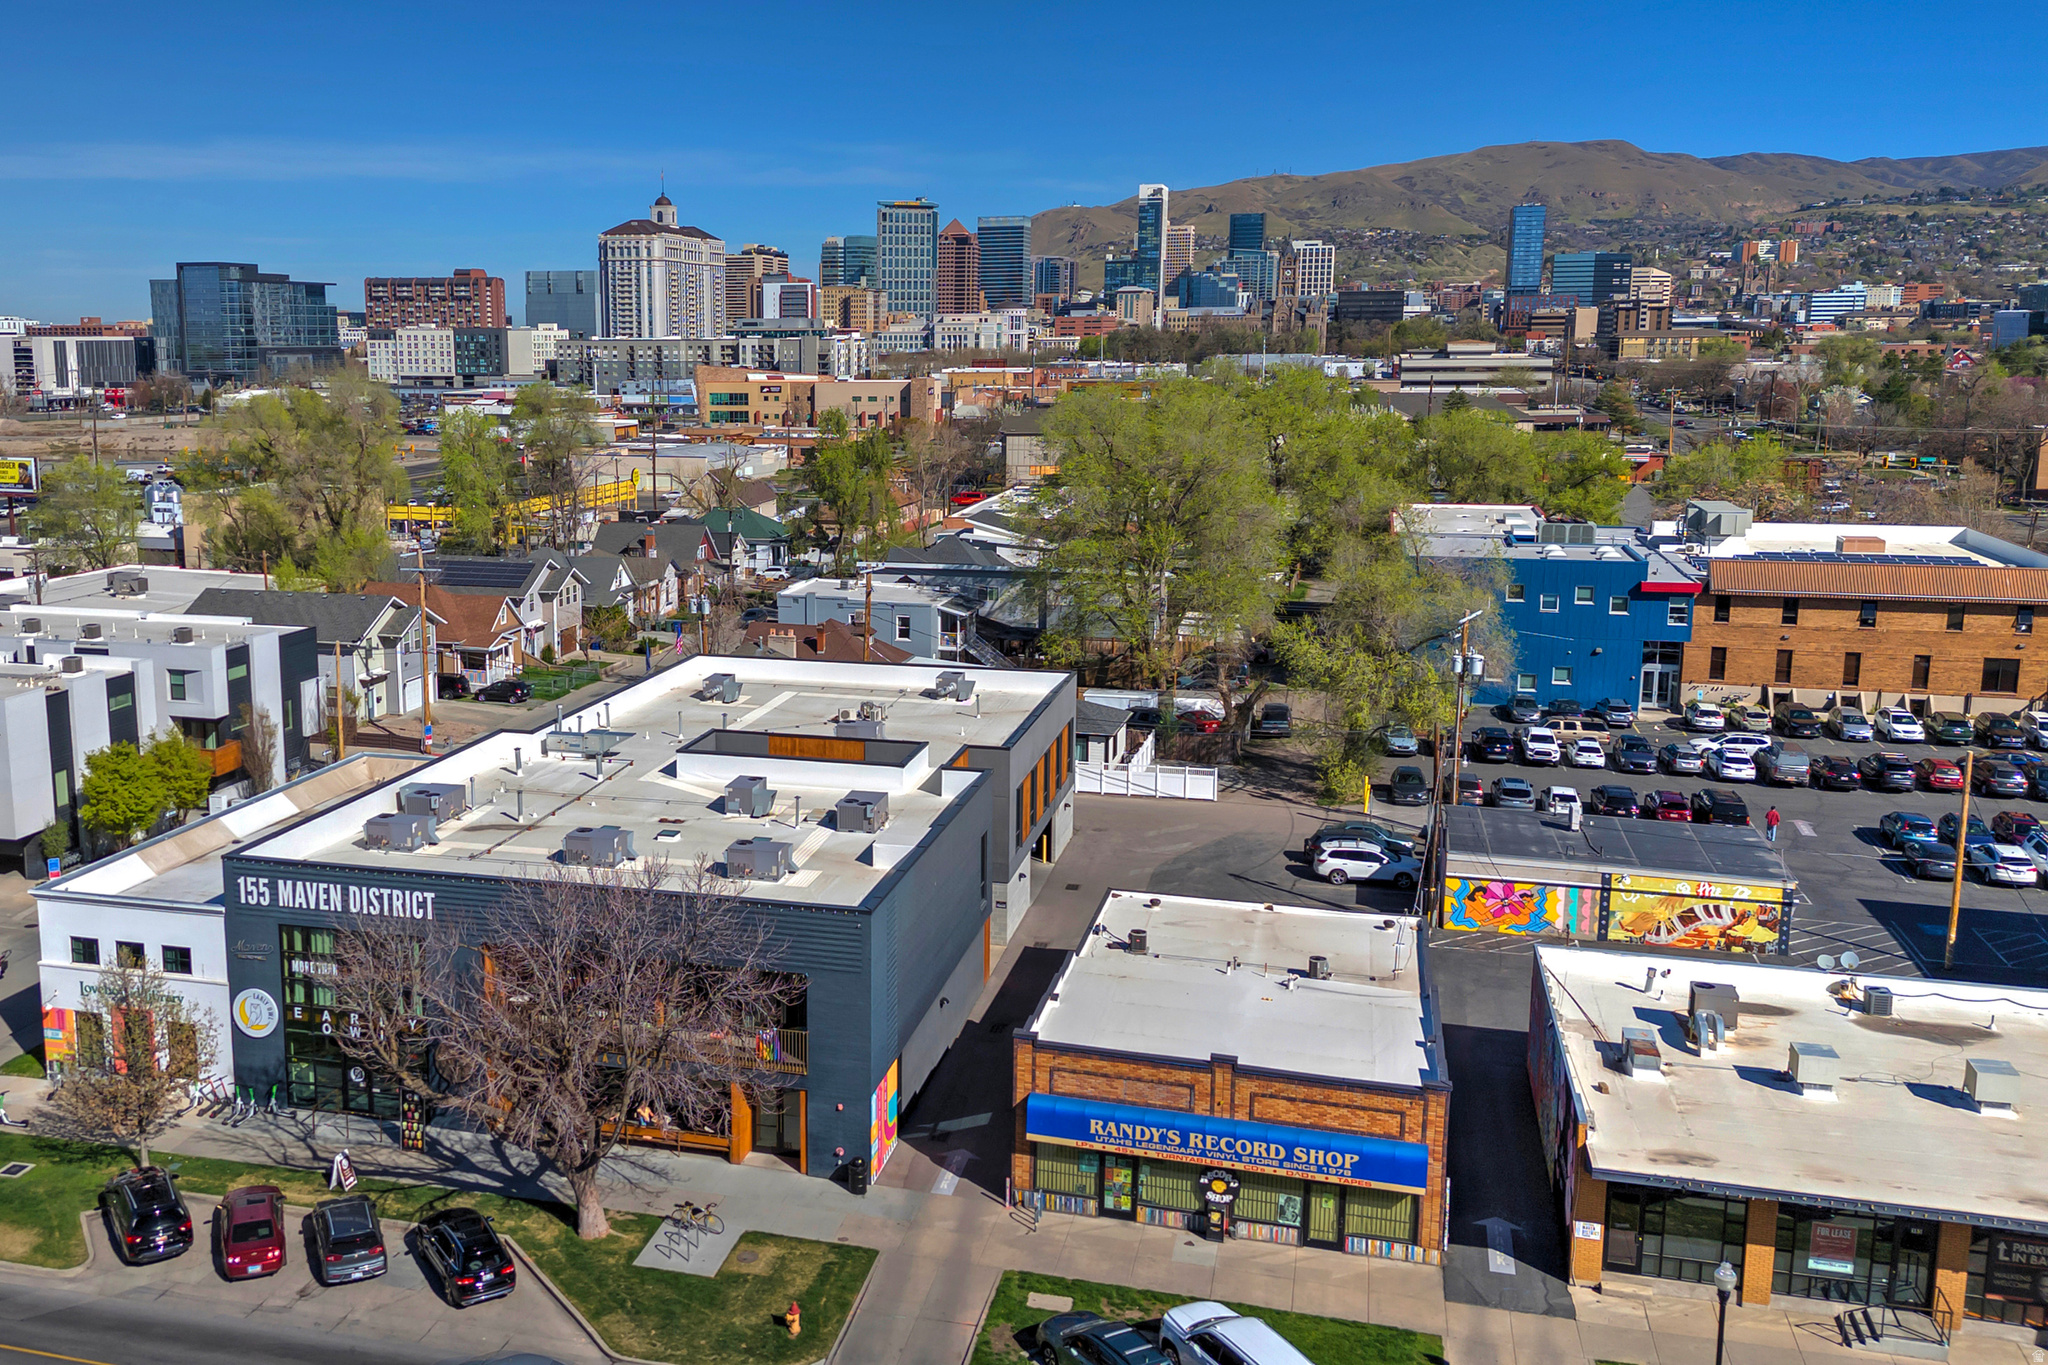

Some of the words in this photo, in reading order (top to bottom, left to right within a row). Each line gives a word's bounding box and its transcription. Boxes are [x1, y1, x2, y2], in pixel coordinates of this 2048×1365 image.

[237, 876, 270, 906] 155
[277, 879, 342, 912] MAVEN
[349, 885, 436, 920] DISTRICT
[291, 960, 315, 973] MORE
[1089, 1119, 1181, 1146] RANDY'S
[1189, 1132, 1286, 1160] RECORD
[1293, 1147, 1360, 1169] SHOP
[1135, 1141, 1202, 1156] LEGENDARY
[1205, 1151, 1239, 1162] VINYL
[1242, 1156, 1280, 1167] STORE
[1283, 1161, 1318, 1173] SINCE
[1322, 1166, 1352, 1177] 1978
[1155, 1151, 1224, 1167] TURNTABLES
[1337, 1176, 1372, 1188] TAPES
[1199, 1170, 1239, 1188] RECORD
[1205, 1191, 1234, 1204] SHOP
[1816, 1226, 1830, 1236] FOR
[1831, 1228, 1852, 1240] LEASE
[2011, 1252, 2027, 1263] IN
